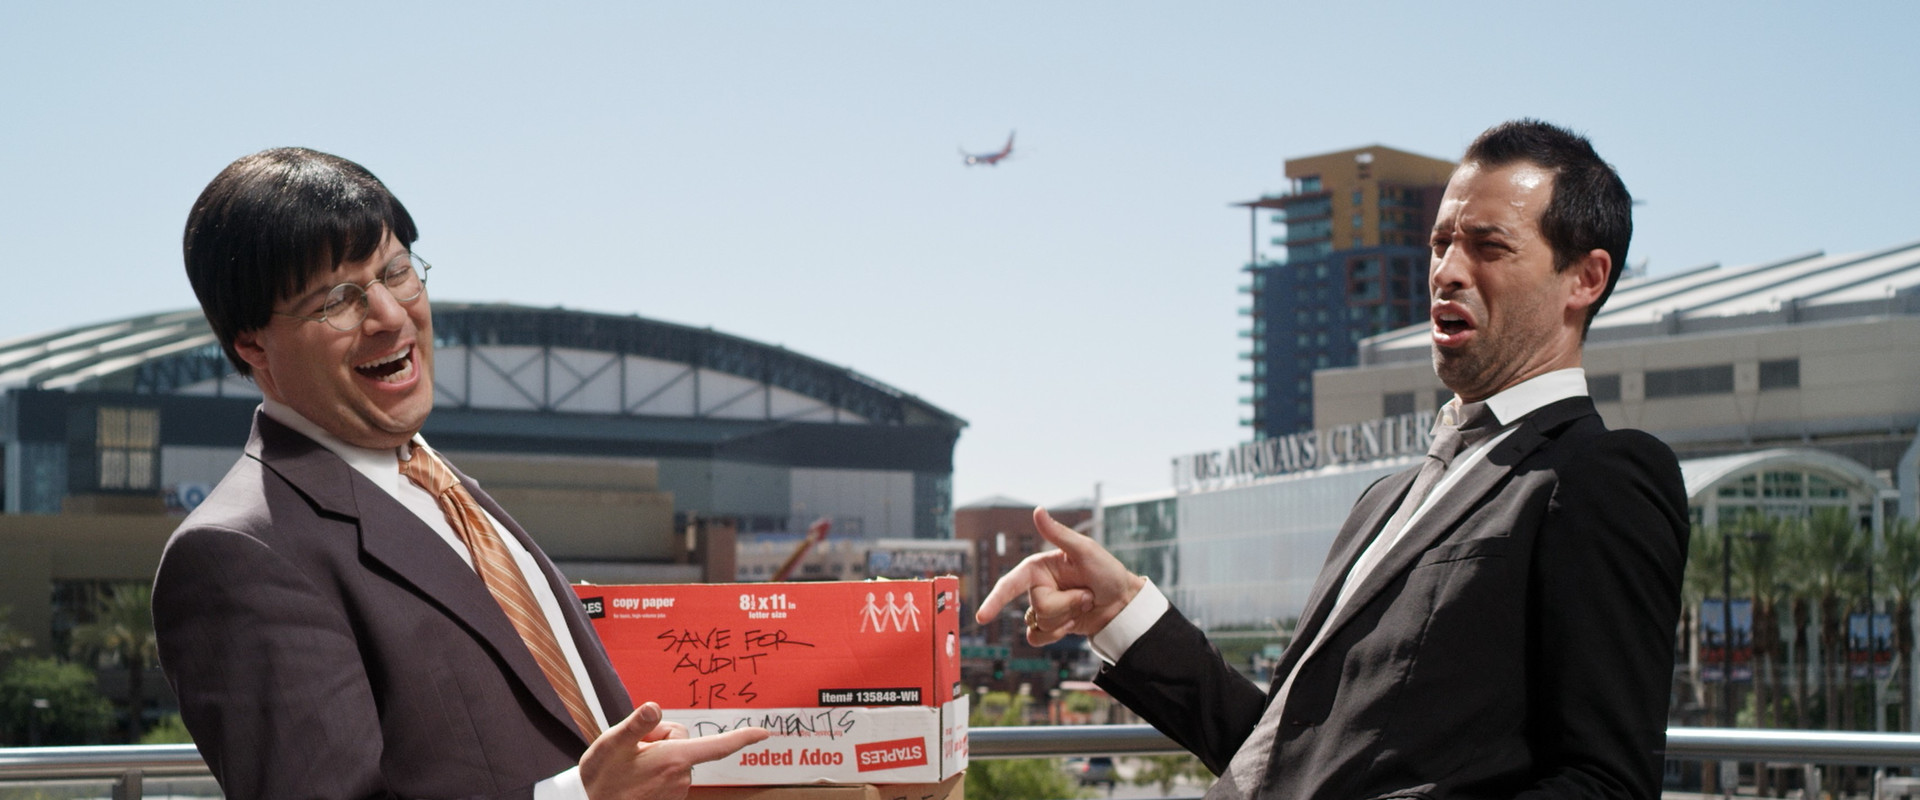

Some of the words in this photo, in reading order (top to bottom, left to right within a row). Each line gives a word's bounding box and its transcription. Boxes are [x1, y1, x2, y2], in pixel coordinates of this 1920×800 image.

[1194, 451, 1221, 480] US
[1226, 431, 1317, 478] AIRWAYS
[1326, 410, 1434, 464] CENTER
[612, 597, 640, 610] copy
[642, 597, 675, 610] paper
[758, 597, 769, 610] x
[769, 593, 786, 610] 11
[748, 611, 769, 619] letter
[771, 611, 787, 619] size
[657, 627, 731, 653] SAVE
[745, 629, 815, 651] FOR
[673, 652, 768, 675] AUDIT
[821, 692, 854, 703] item#
[856, 690, 919, 703] 135848-WH
[739, 748, 793, 767] paper
[799, 748, 844, 766] copy
[861, 745, 923, 765] STAPLES
